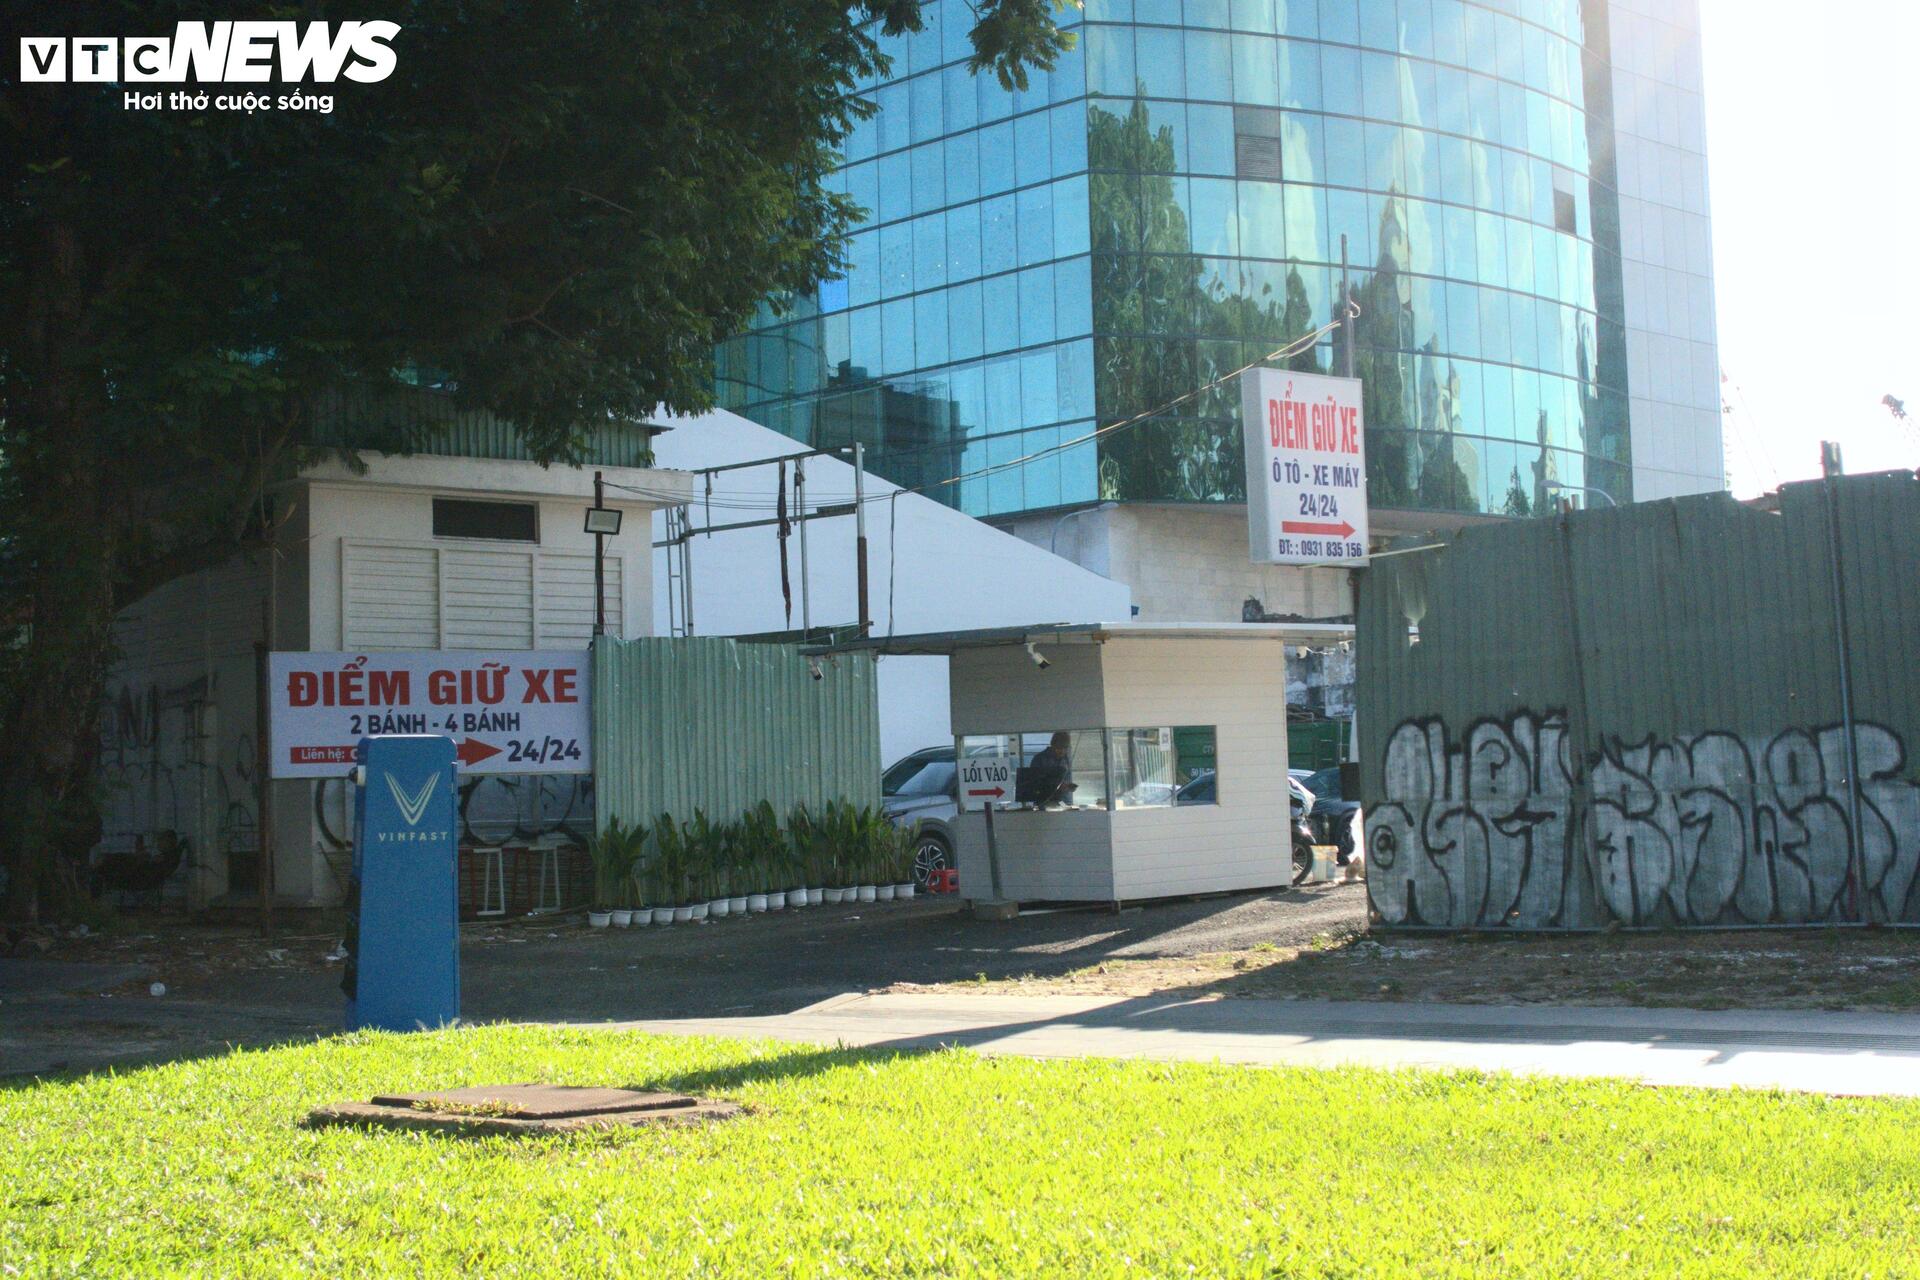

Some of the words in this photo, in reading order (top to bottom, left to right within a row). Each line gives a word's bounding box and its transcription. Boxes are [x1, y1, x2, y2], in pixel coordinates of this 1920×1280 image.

[1269, 380, 1308, 450] ĐIỂM
[1312, 396, 1337, 452] GIỮ
[1339, 406, 1359, 454] XE
[1272, 457, 1281, 483] Ô
[1284, 458, 1301, 484] TÔ
[1313, 464, 1329, 486] XE
[1332, 463, 1360, 488] MÁY
[1301, 540, 1323, 556] 0931
[1326, 541, 1344, 557] 835
[1346, 542, 1362, 558] 156
[287, 655, 411, 707] ĐIỂM
[427, 662, 511, 706] GIỮ
[521, 668, 579, 704] XE
[350, 714, 362, 735] 2
[367, 708, 427, 734] BÁNH
[445, 714, 458, 733] 4
[463, 708, 521, 733] BÁNH
[301, 748, 325, 760] Liên
[327, 748, 345, 762] hệ:
[506, 735, 582, 764] 24/24
[963, 760, 983, 783] LỐI
[984, 762, 1008, 782] VÀO
[378, 830, 450, 843] VINFAST
